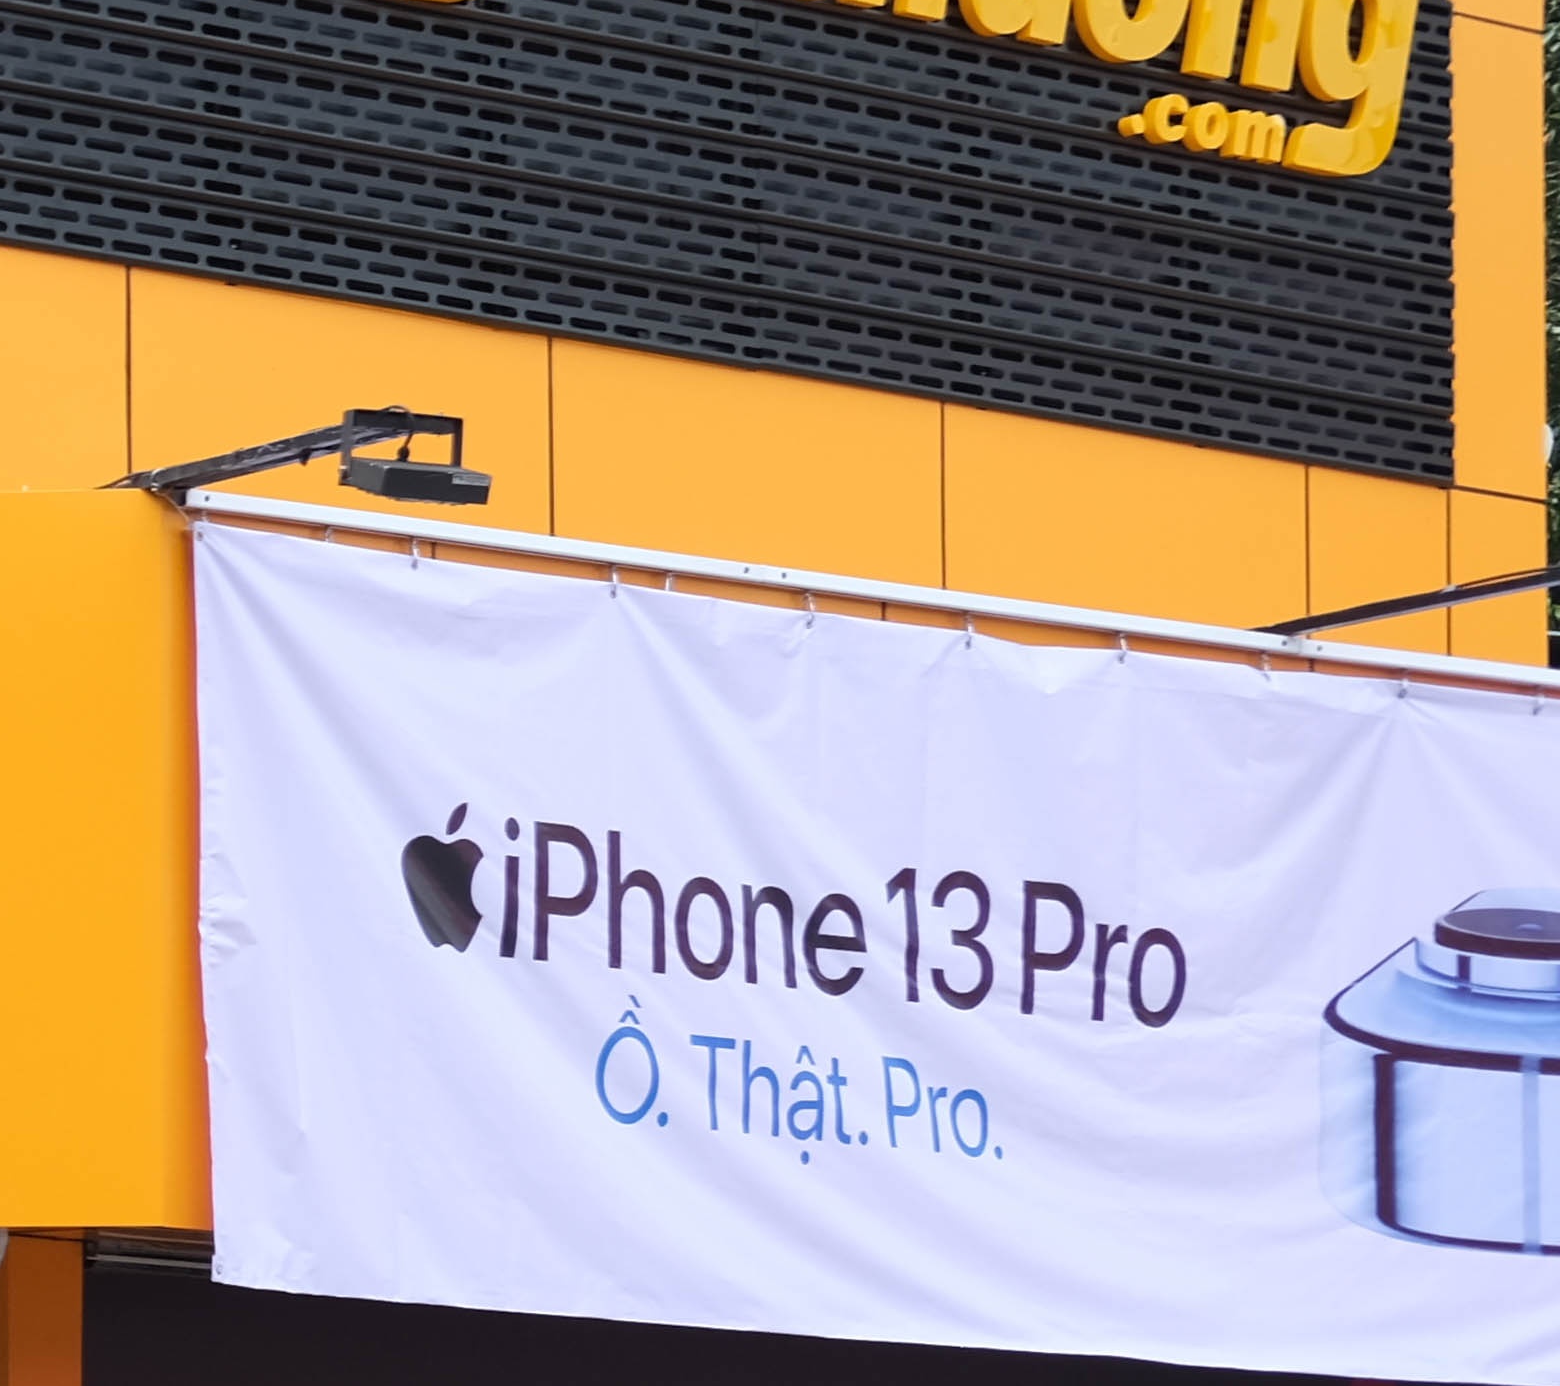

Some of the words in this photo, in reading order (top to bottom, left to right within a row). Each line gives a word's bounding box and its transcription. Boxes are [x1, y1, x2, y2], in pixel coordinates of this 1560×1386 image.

[1118, 86, 1288, 166] .com
[499, 816, 868, 998] iPhone
[885, 865, 995, 1012] 13
[1018, 879, 1188, 1031] Pro
[689, 1033, 869, 1167] Thật.
[883, 1054, 1005, 1162] Pro.
